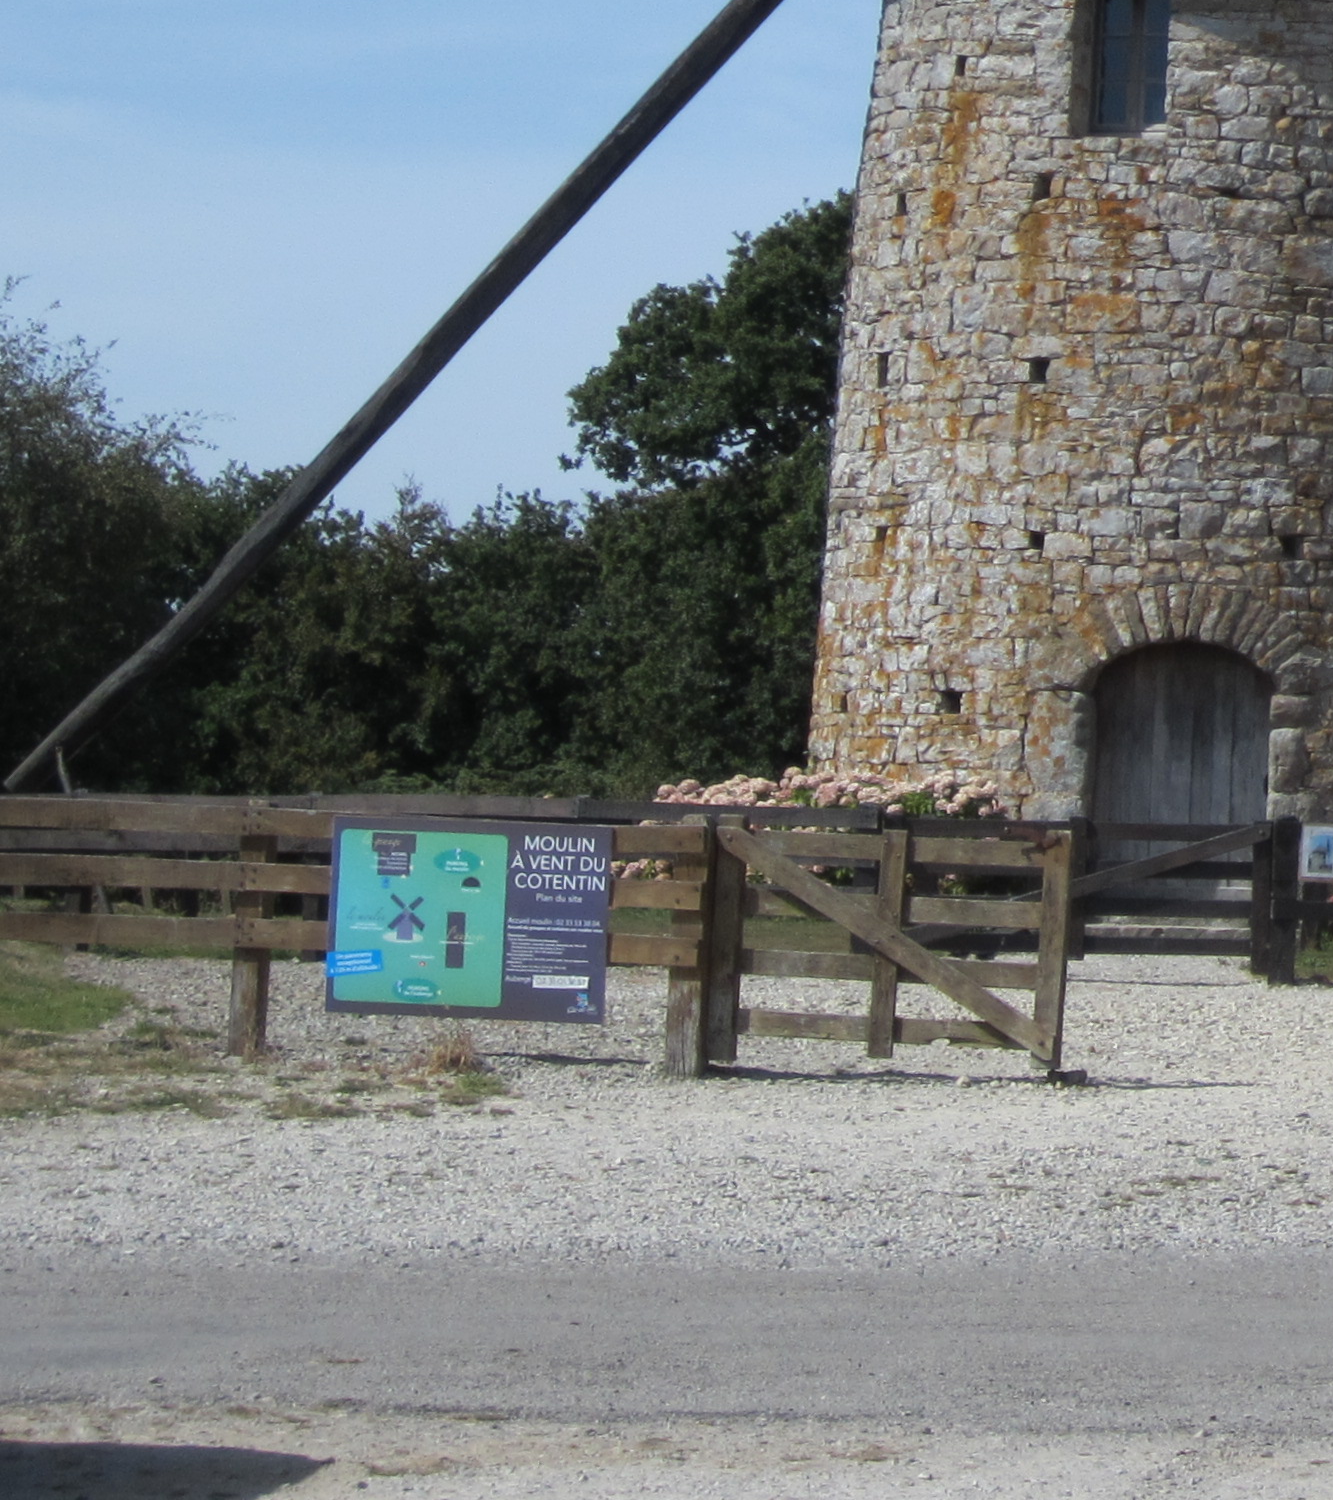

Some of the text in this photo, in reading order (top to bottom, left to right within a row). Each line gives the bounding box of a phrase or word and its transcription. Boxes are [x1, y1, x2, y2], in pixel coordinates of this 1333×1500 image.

[524, 835, 595, 853] MOULIN
[510, 849, 606, 873] À VENT DU
[514, 872, 606, 891] COTENTIN
